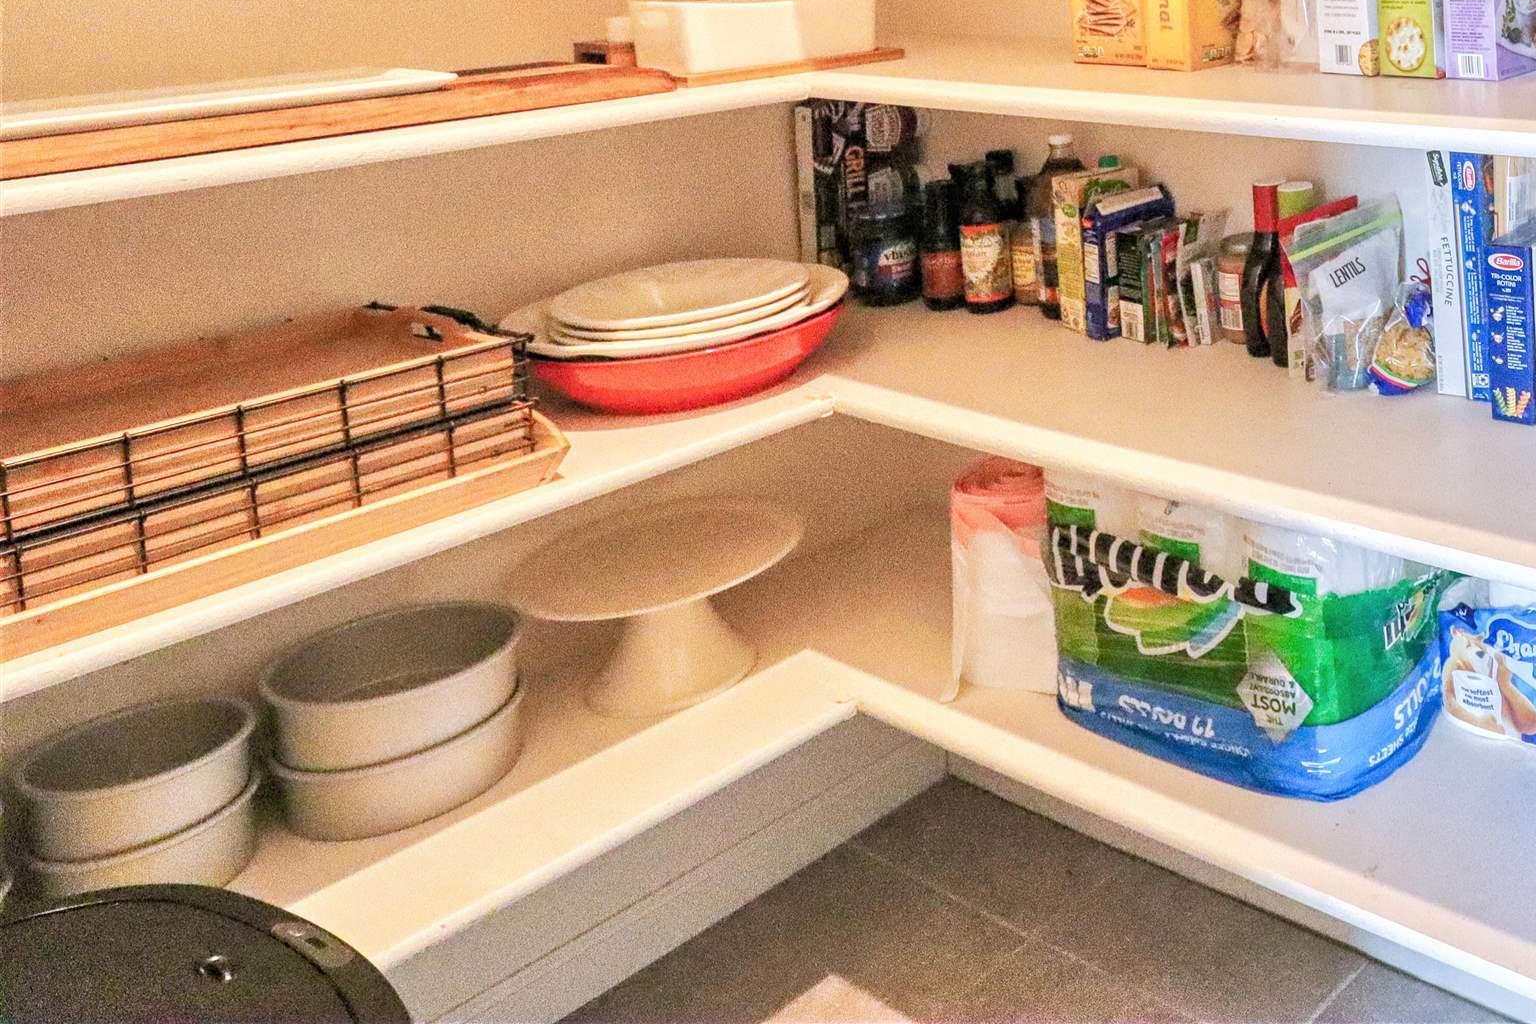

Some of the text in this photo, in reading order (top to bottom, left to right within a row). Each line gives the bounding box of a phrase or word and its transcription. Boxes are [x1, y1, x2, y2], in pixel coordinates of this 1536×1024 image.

[1329, 257, 1366, 288] LENTILS
[1439, 235, 1455, 307] FETTUCCINE
[1490, 272, 1522, 282] TRI-COLOR
[1497, 280, 1516, 288] ROTINI
[1250, 693, 1297, 717] MOST
[1367, 735, 1405, 767] SHEETS
